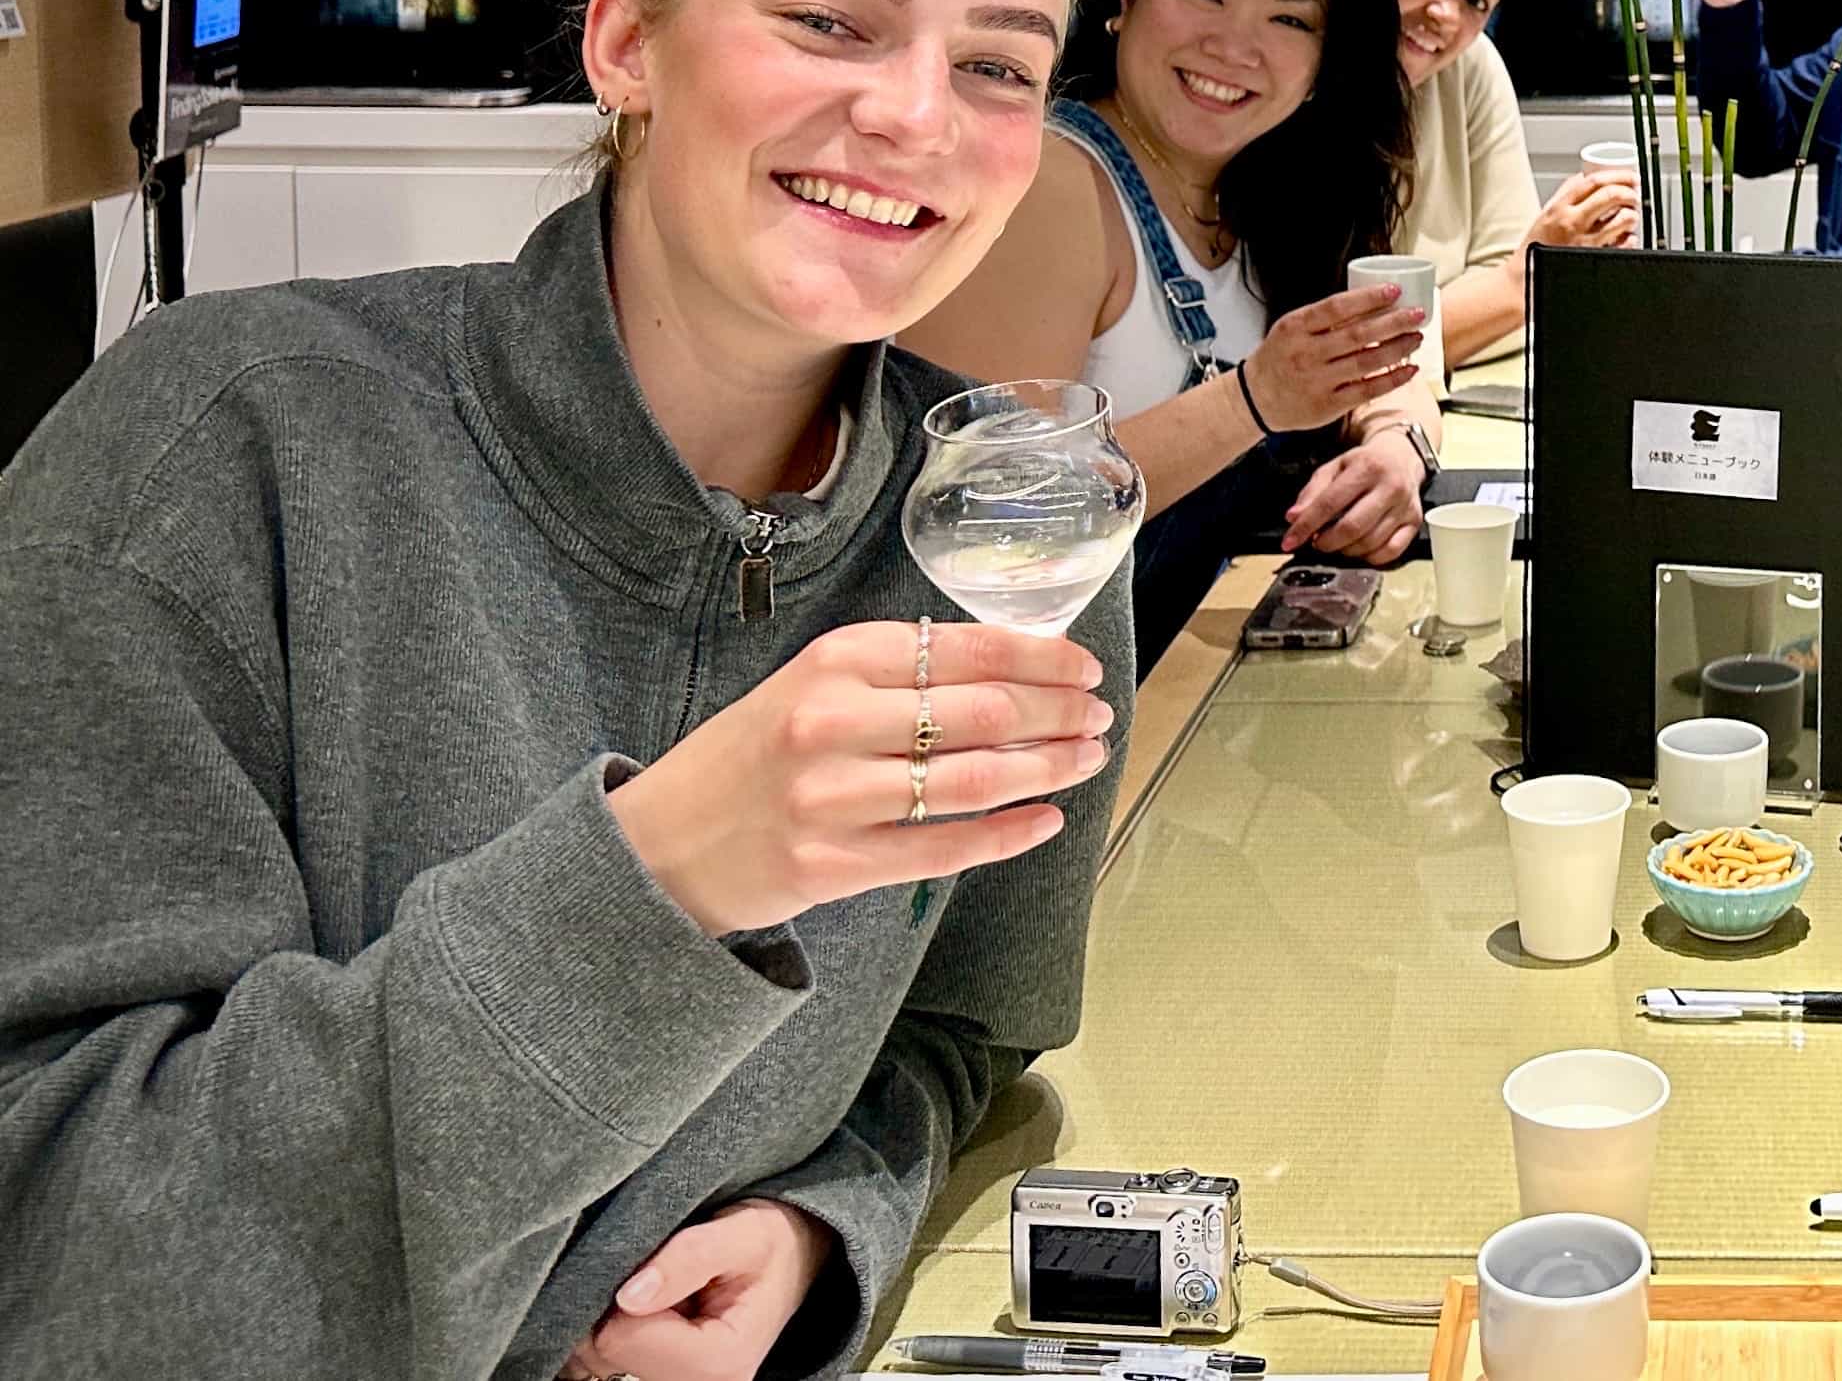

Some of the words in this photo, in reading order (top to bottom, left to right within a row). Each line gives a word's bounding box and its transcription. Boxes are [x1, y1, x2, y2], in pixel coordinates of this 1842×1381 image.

[1648, 449, 1761, 470] 体験メニューブック
